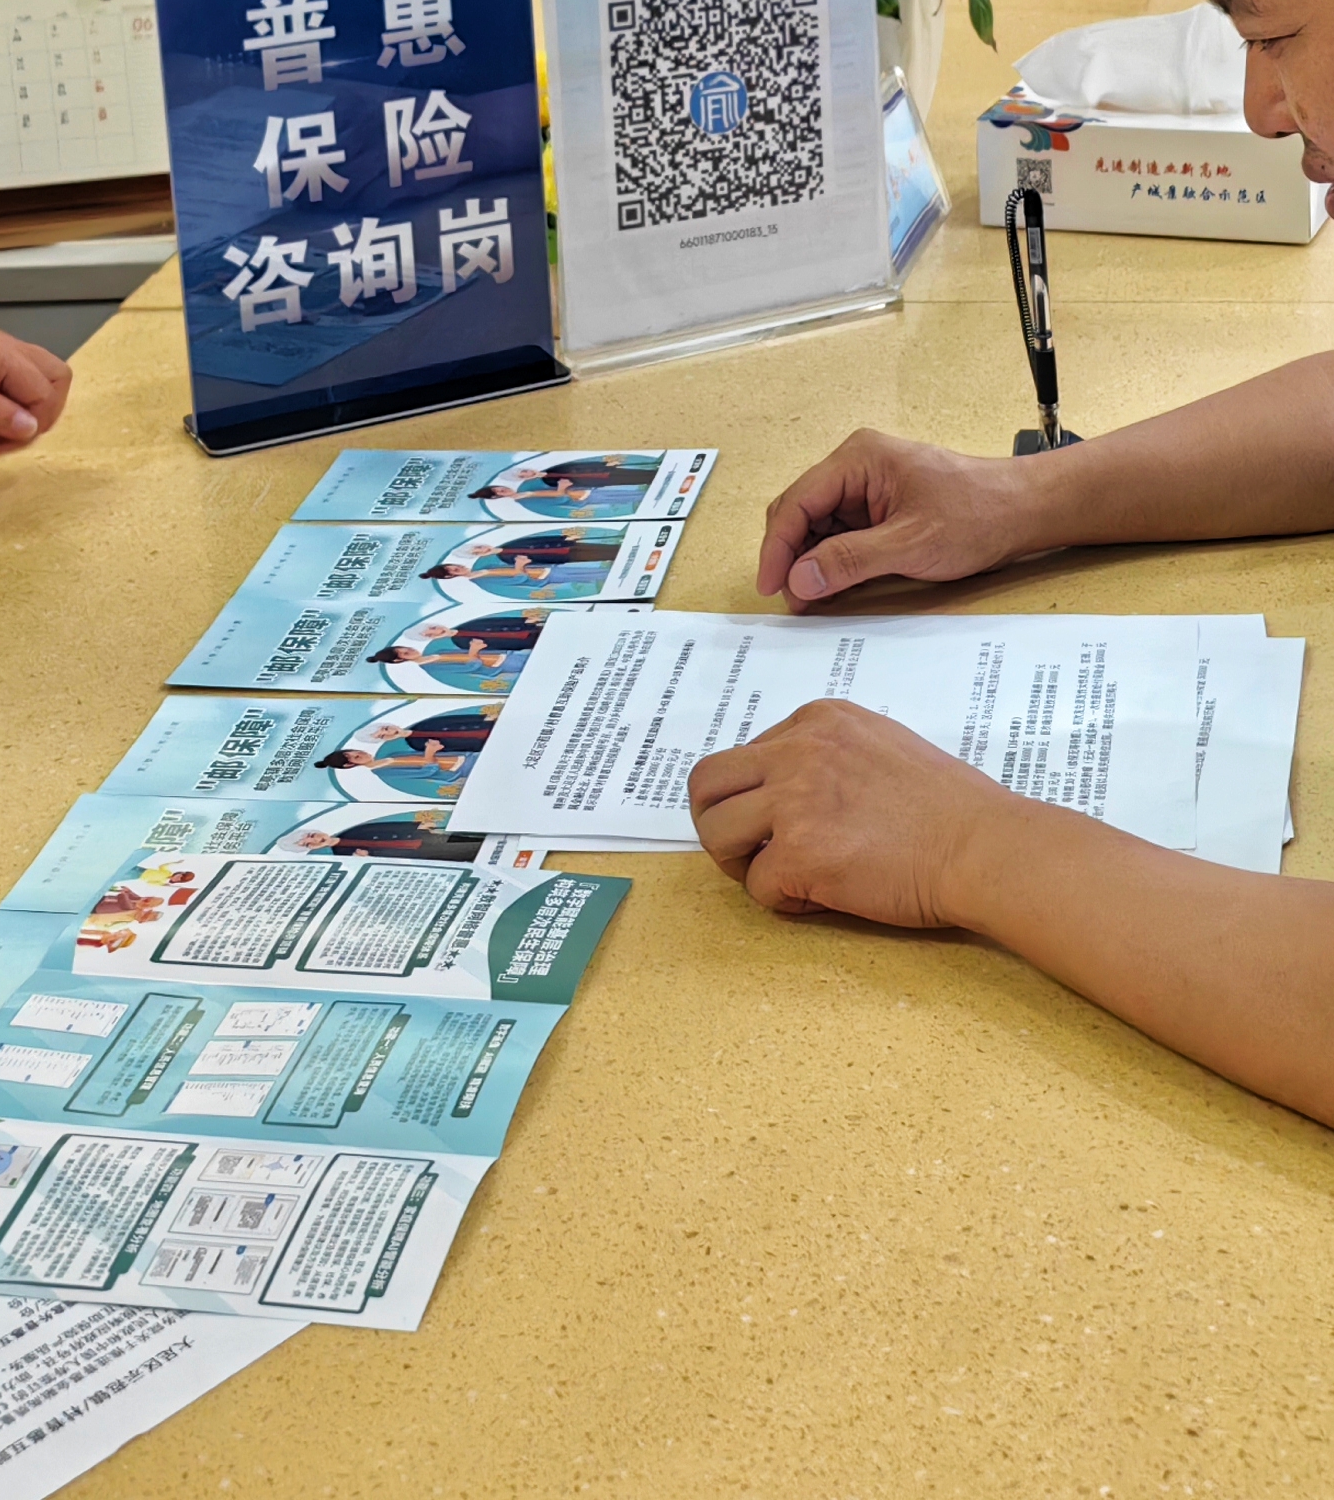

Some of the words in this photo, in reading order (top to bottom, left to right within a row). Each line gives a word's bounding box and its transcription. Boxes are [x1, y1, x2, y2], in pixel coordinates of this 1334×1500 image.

[253, 91, 474, 209] 保险
[222, 197, 516, 332] 咨询岗
